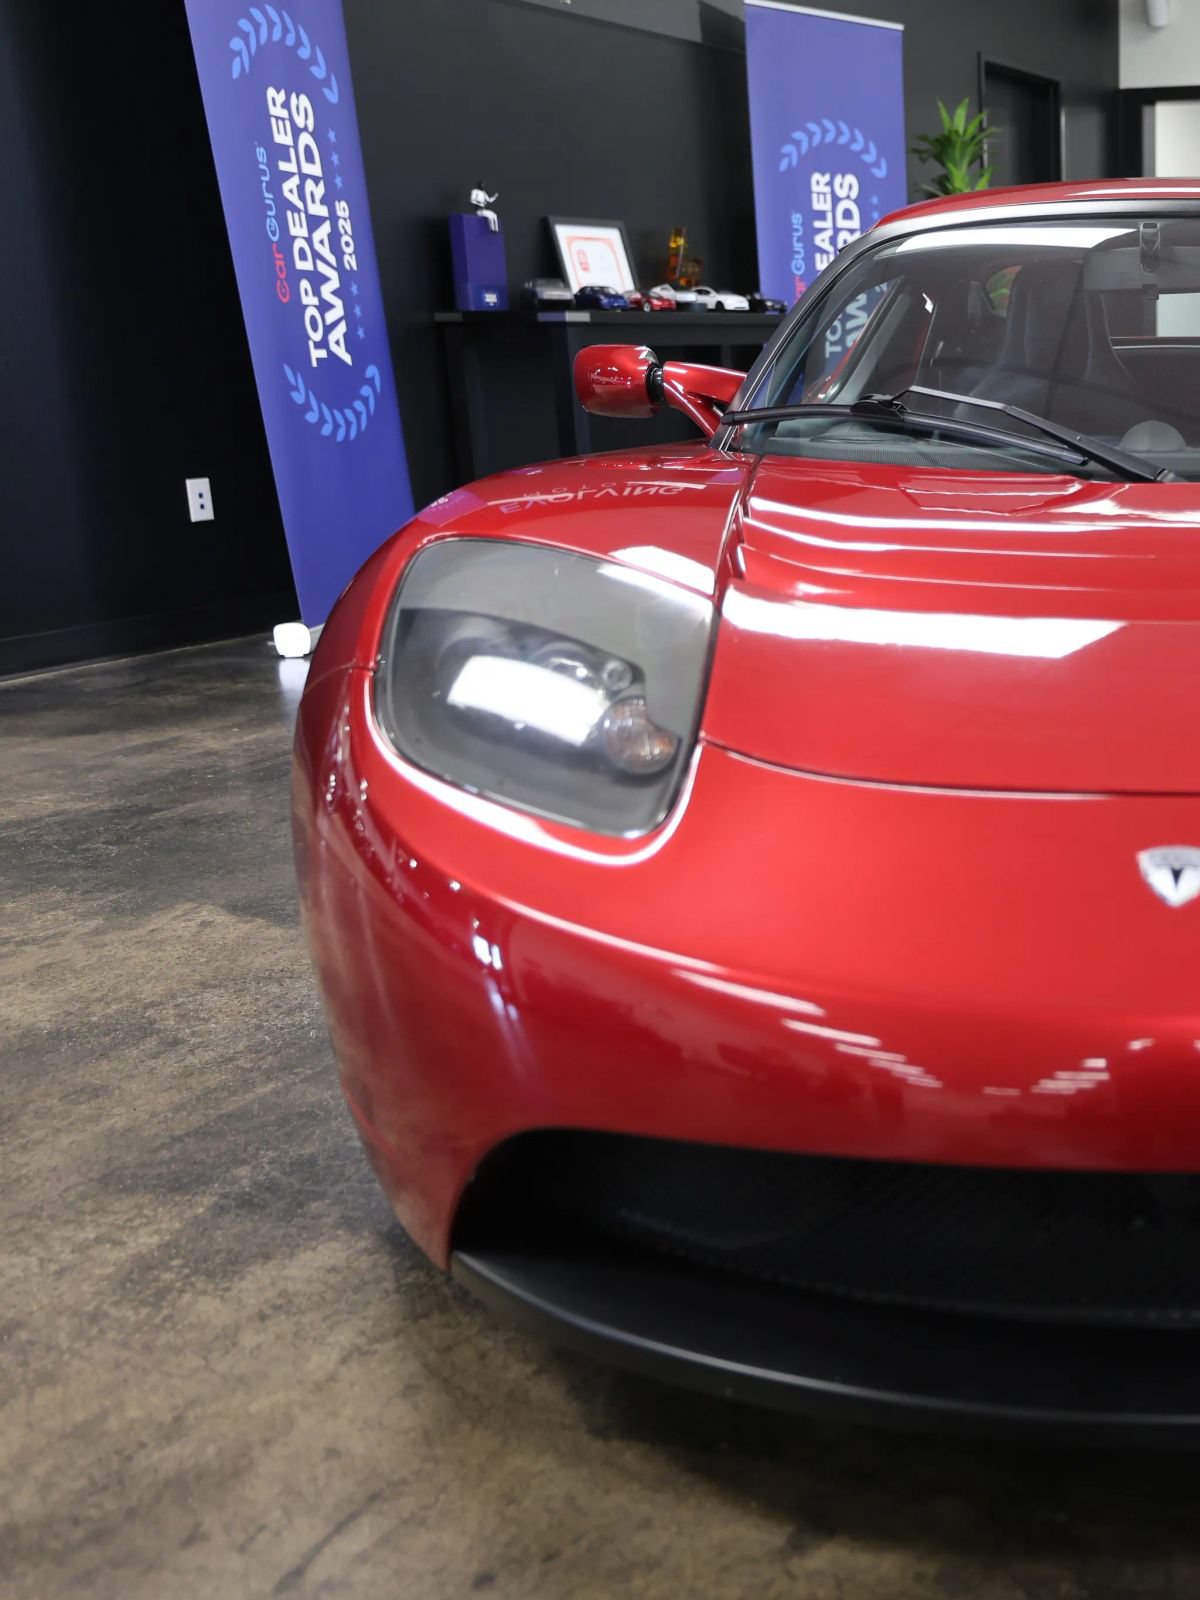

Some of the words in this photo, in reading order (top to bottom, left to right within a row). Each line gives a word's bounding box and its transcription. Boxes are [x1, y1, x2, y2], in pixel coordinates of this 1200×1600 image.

[256, 146, 290, 303] CarGurus
[266, 86, 314, 271] DEALER
[290, 91, 353, 366] AWARDS
[811, 171, 835, 275] EALER
[334, 199, 357, 271] 2025
[299, 278, 328, 367] TOP
[825, 315, 842, 358] TO
